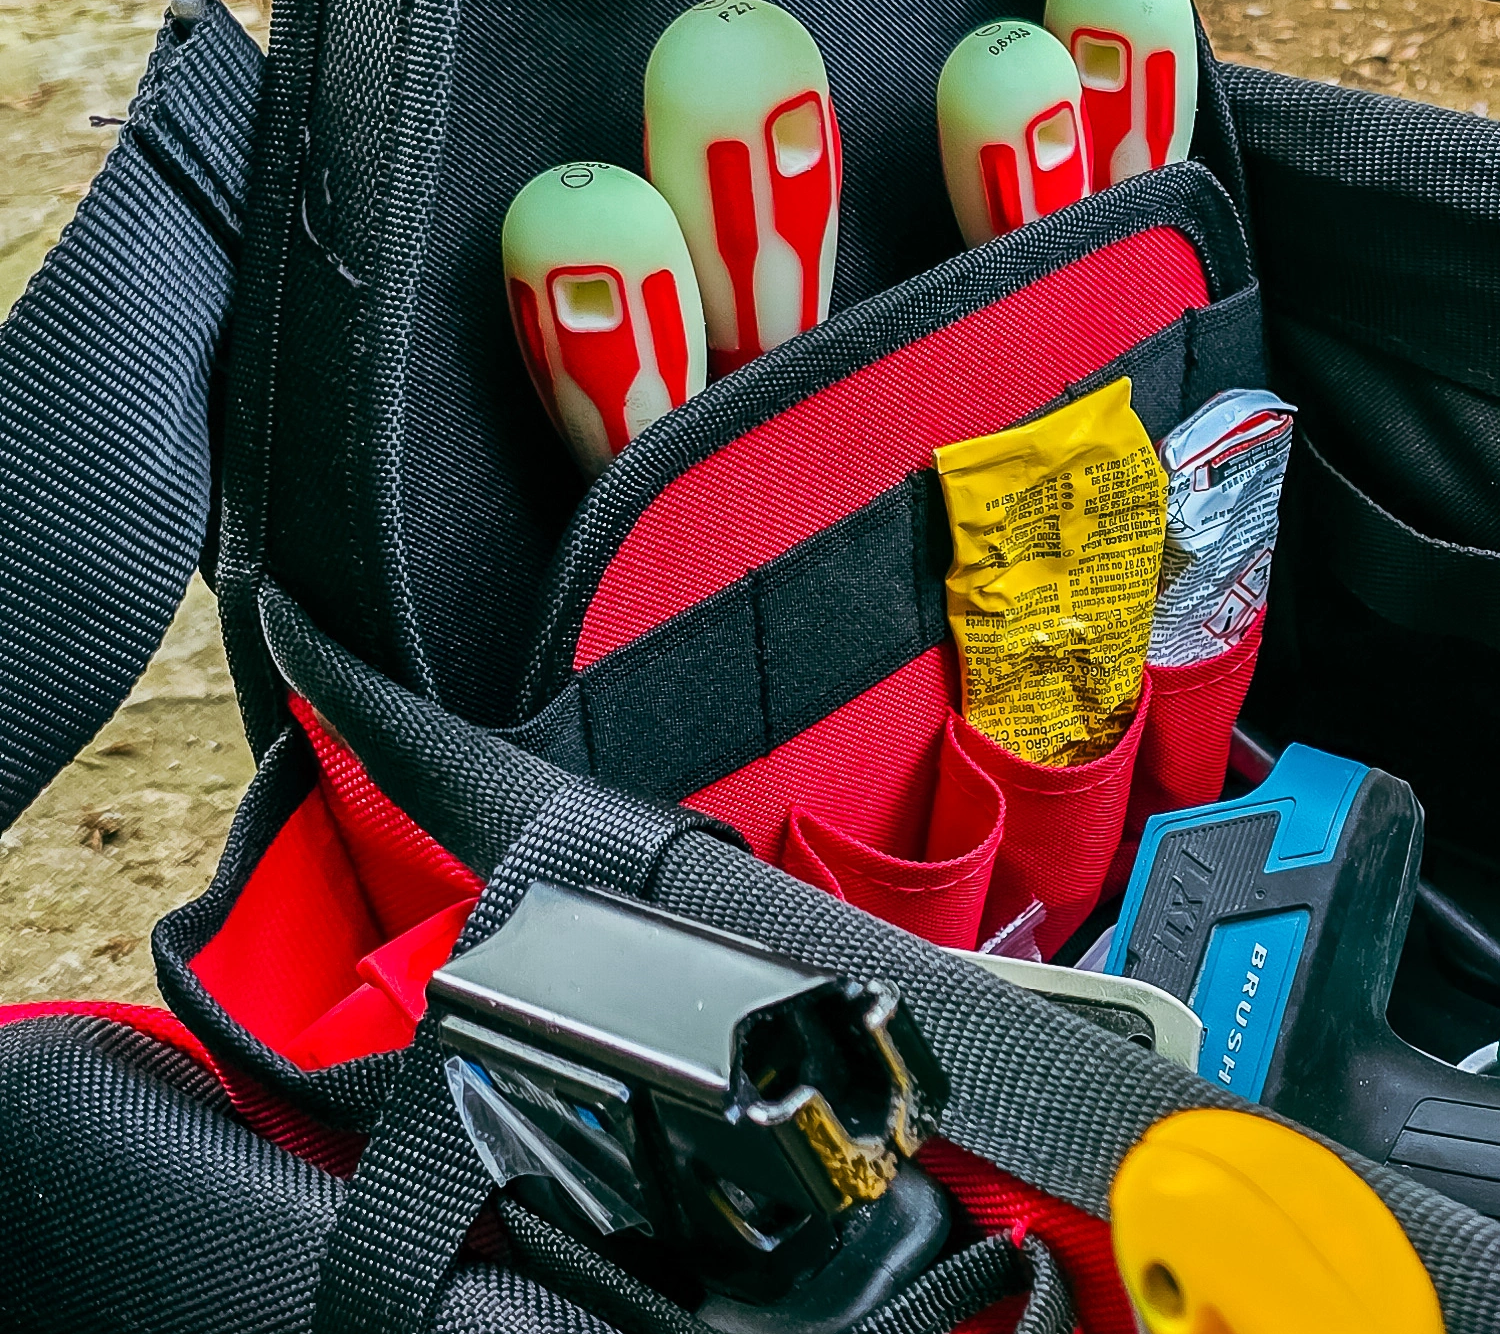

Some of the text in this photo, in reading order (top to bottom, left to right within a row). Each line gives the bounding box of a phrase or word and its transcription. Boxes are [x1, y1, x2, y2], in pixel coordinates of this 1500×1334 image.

[718, 1, 757, 23] PZ2
[1070, 586, 1089, 599] pour
[1022, 731, 1071, 751] PELIGRO.
